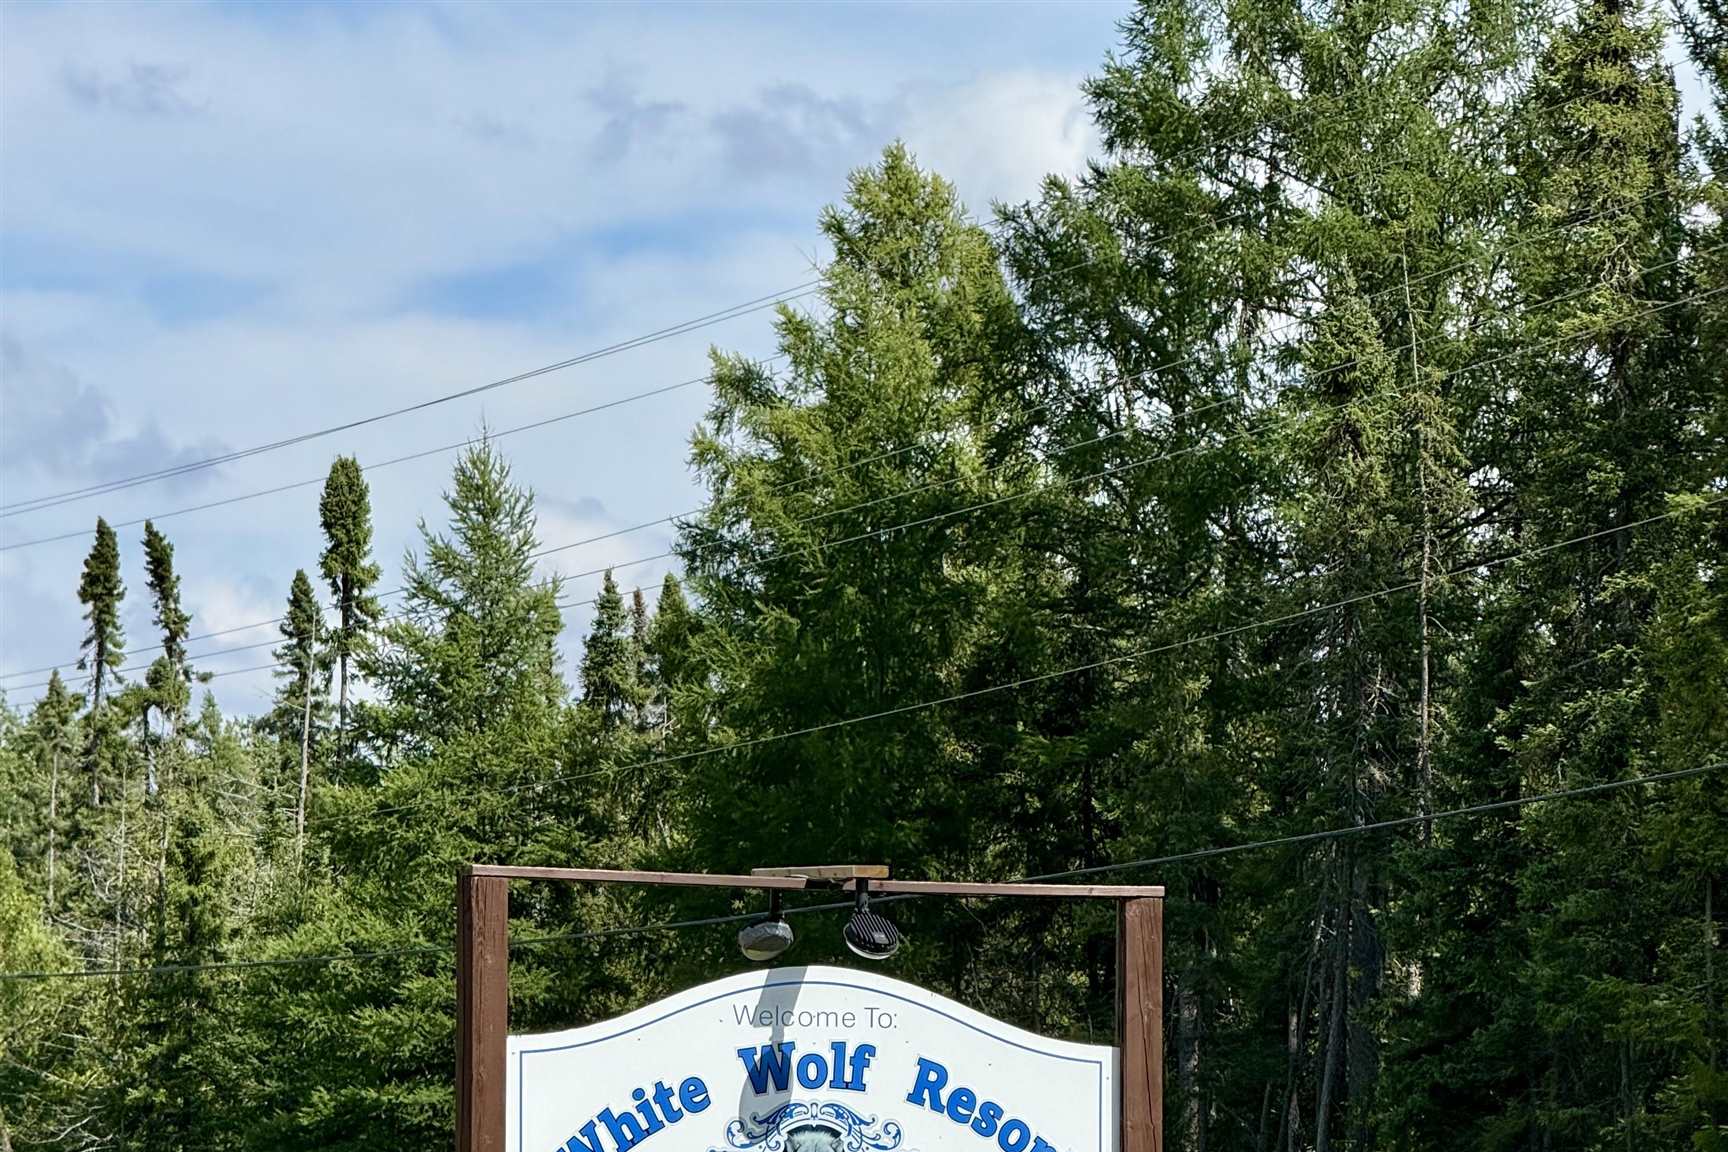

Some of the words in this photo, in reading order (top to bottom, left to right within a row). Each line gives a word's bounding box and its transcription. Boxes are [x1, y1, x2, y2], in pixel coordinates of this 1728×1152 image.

[733, 1004, 857, 1028] Welcome
[864, 1006, 898, 1029] To:
[737, 1041, 876, 1095] Wolf
